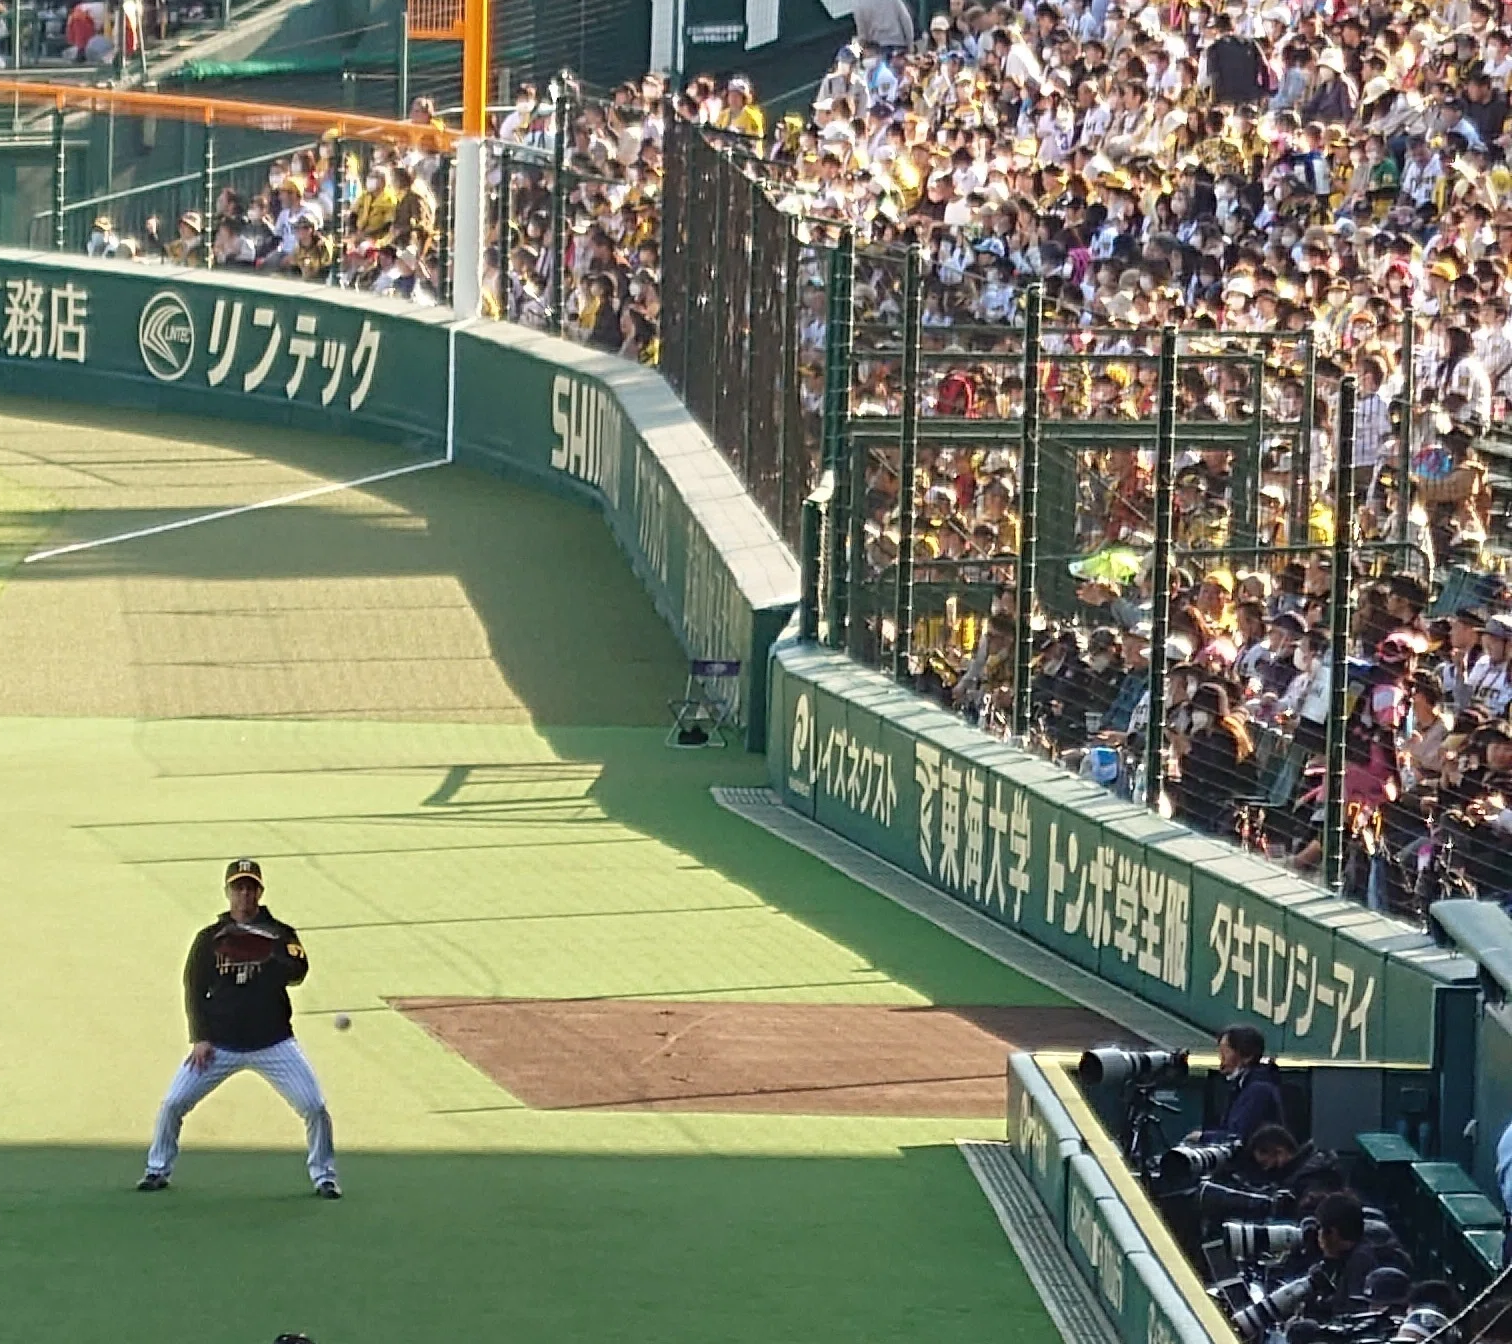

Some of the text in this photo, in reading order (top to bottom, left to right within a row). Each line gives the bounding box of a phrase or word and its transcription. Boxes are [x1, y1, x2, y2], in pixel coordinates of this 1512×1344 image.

[207, 299, 381, 412] リンテック
[939, 757, 1032, 924] 東海大学
[1046, 821, 1189, 992] トンボ学生服
[1209, 902, 1376, 1062] タキロンシーアイ
